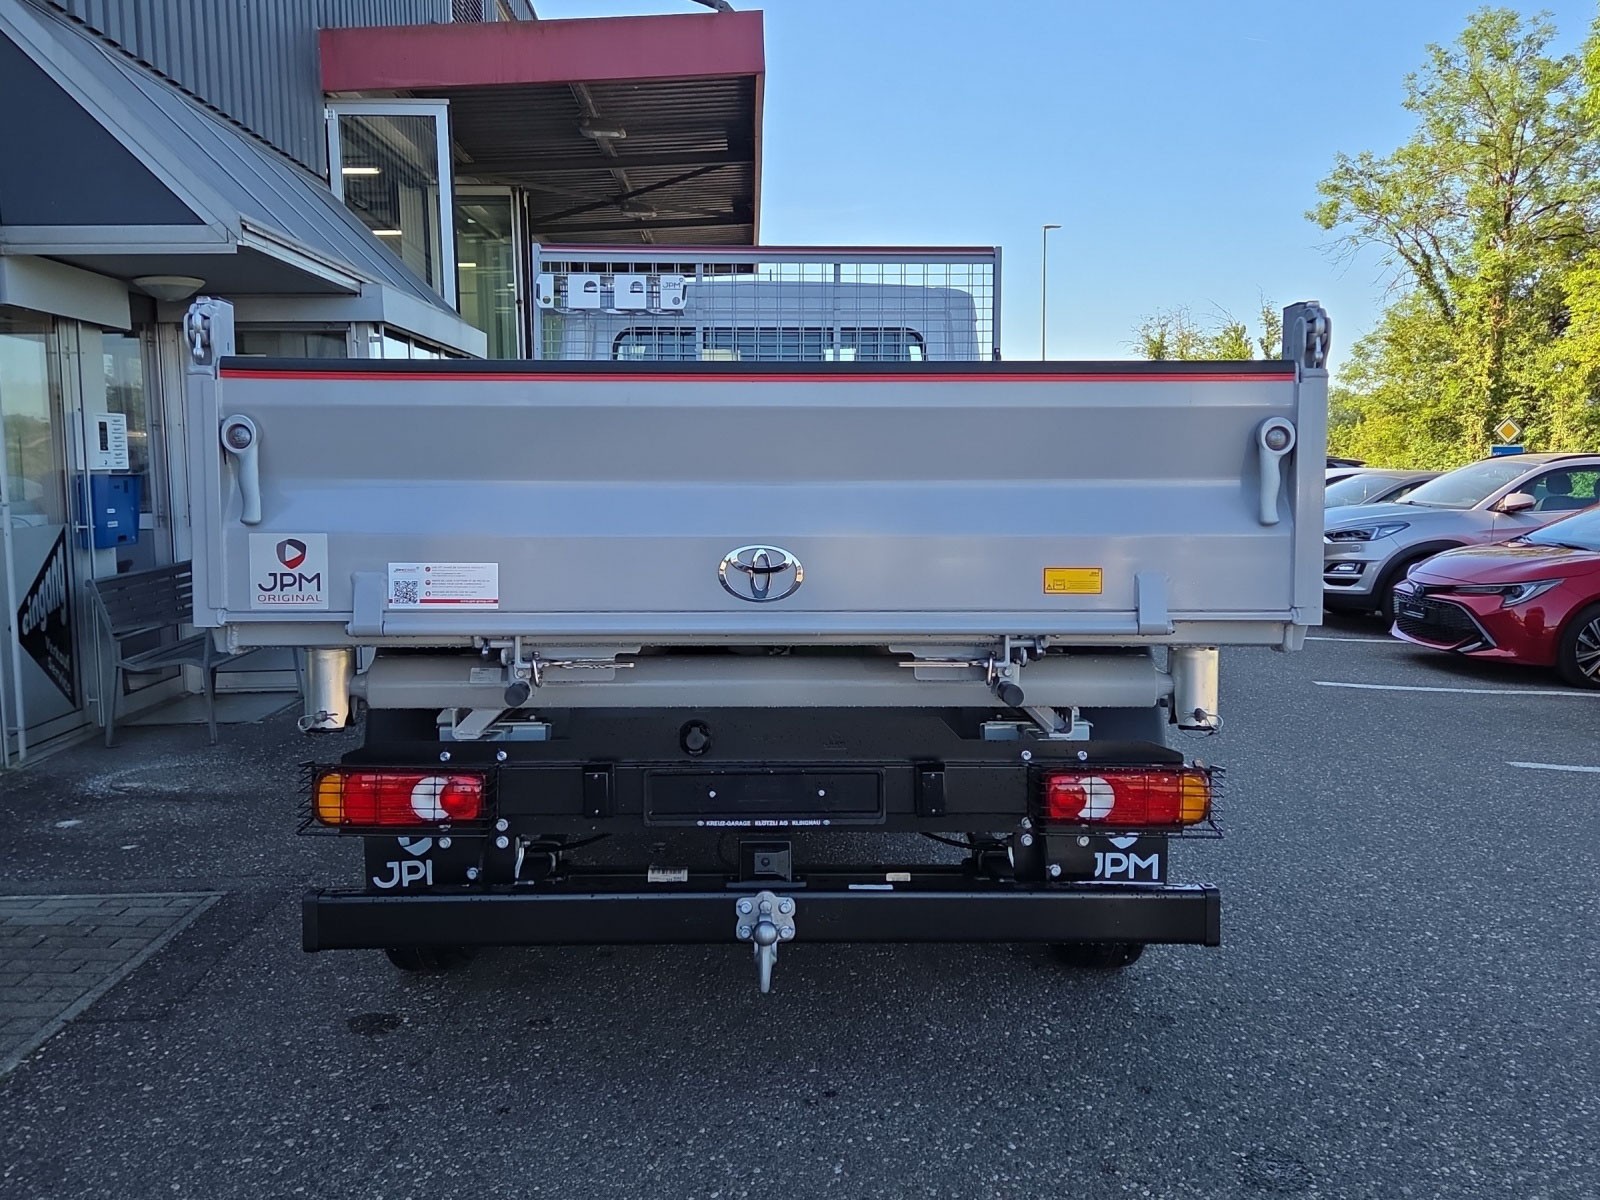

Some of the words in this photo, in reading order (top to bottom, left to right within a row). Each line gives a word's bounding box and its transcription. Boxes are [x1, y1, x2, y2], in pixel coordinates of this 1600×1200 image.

[663, 281, 681, 289] JPM
[257, 572, 321, 592] JPM
[257, 594, 322, 602] ORIGINAL
[1094, 852, 1159, 880] JPM
